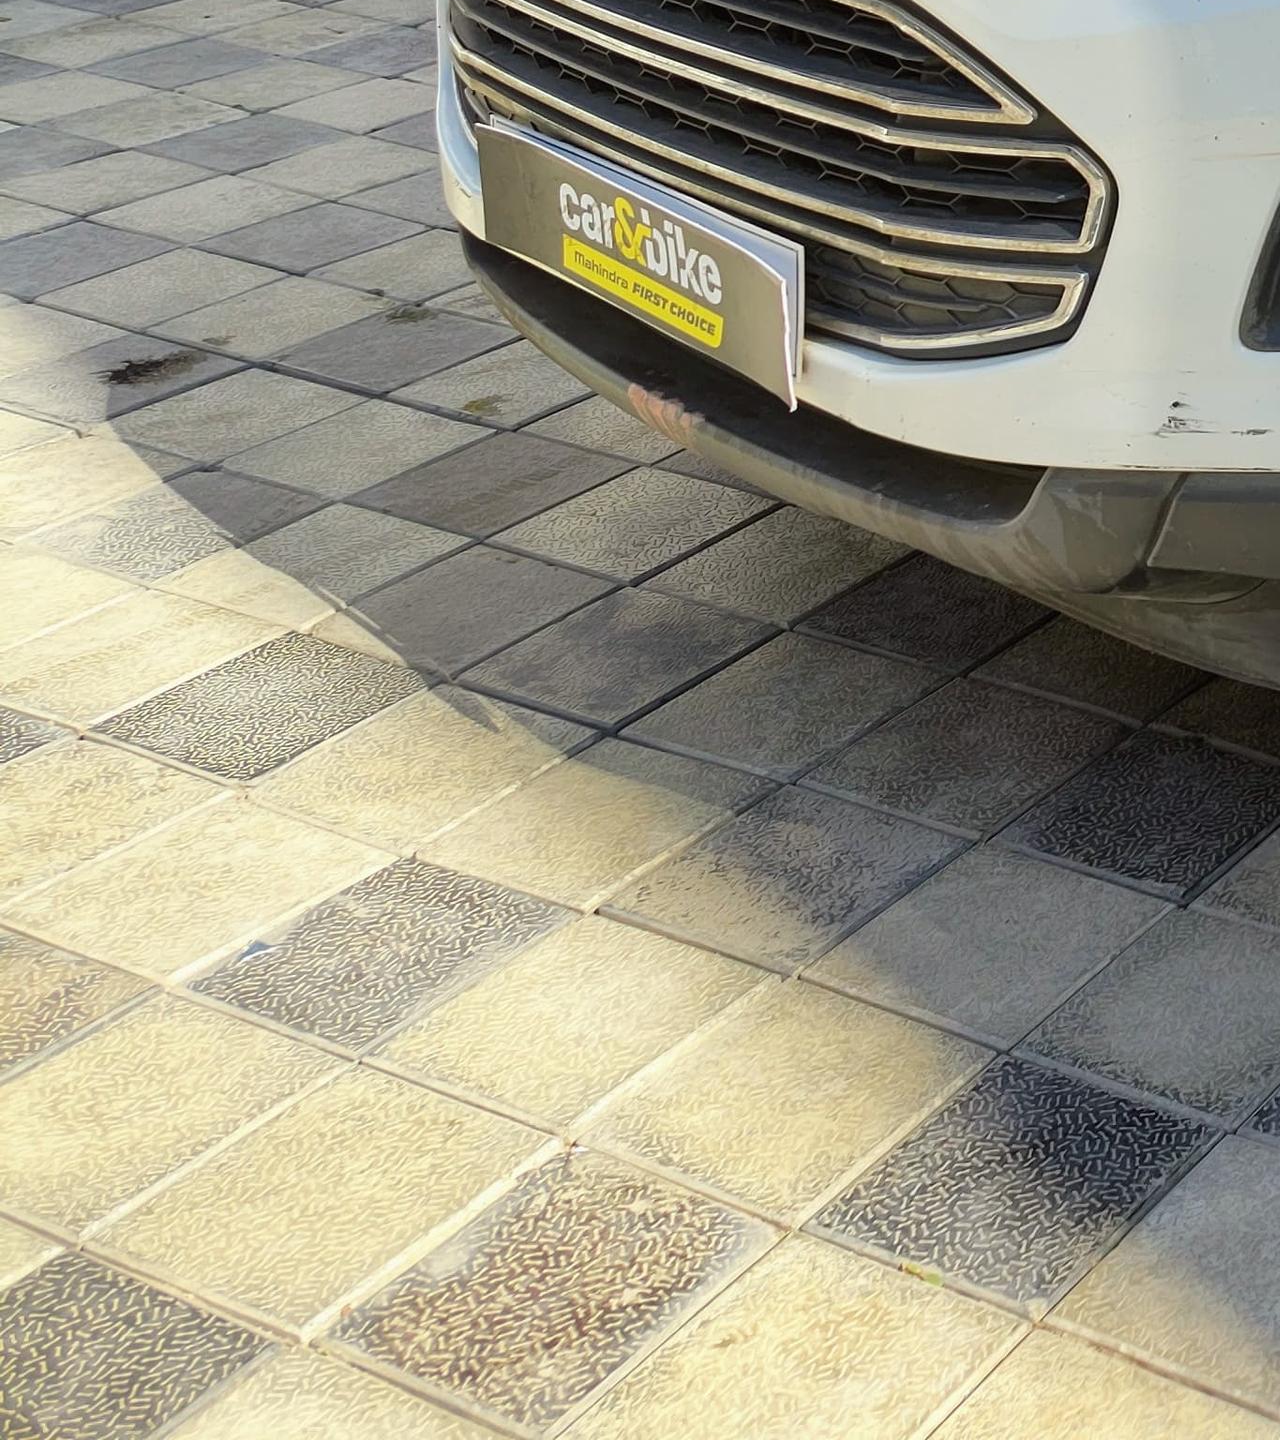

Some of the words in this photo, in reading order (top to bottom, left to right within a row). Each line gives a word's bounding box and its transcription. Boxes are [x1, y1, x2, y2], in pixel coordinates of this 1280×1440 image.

[559, 182, 723, 305] car&bike
[631, 282, 669, 310] FIRST
[669, 303, 716, 336] CHOICE
